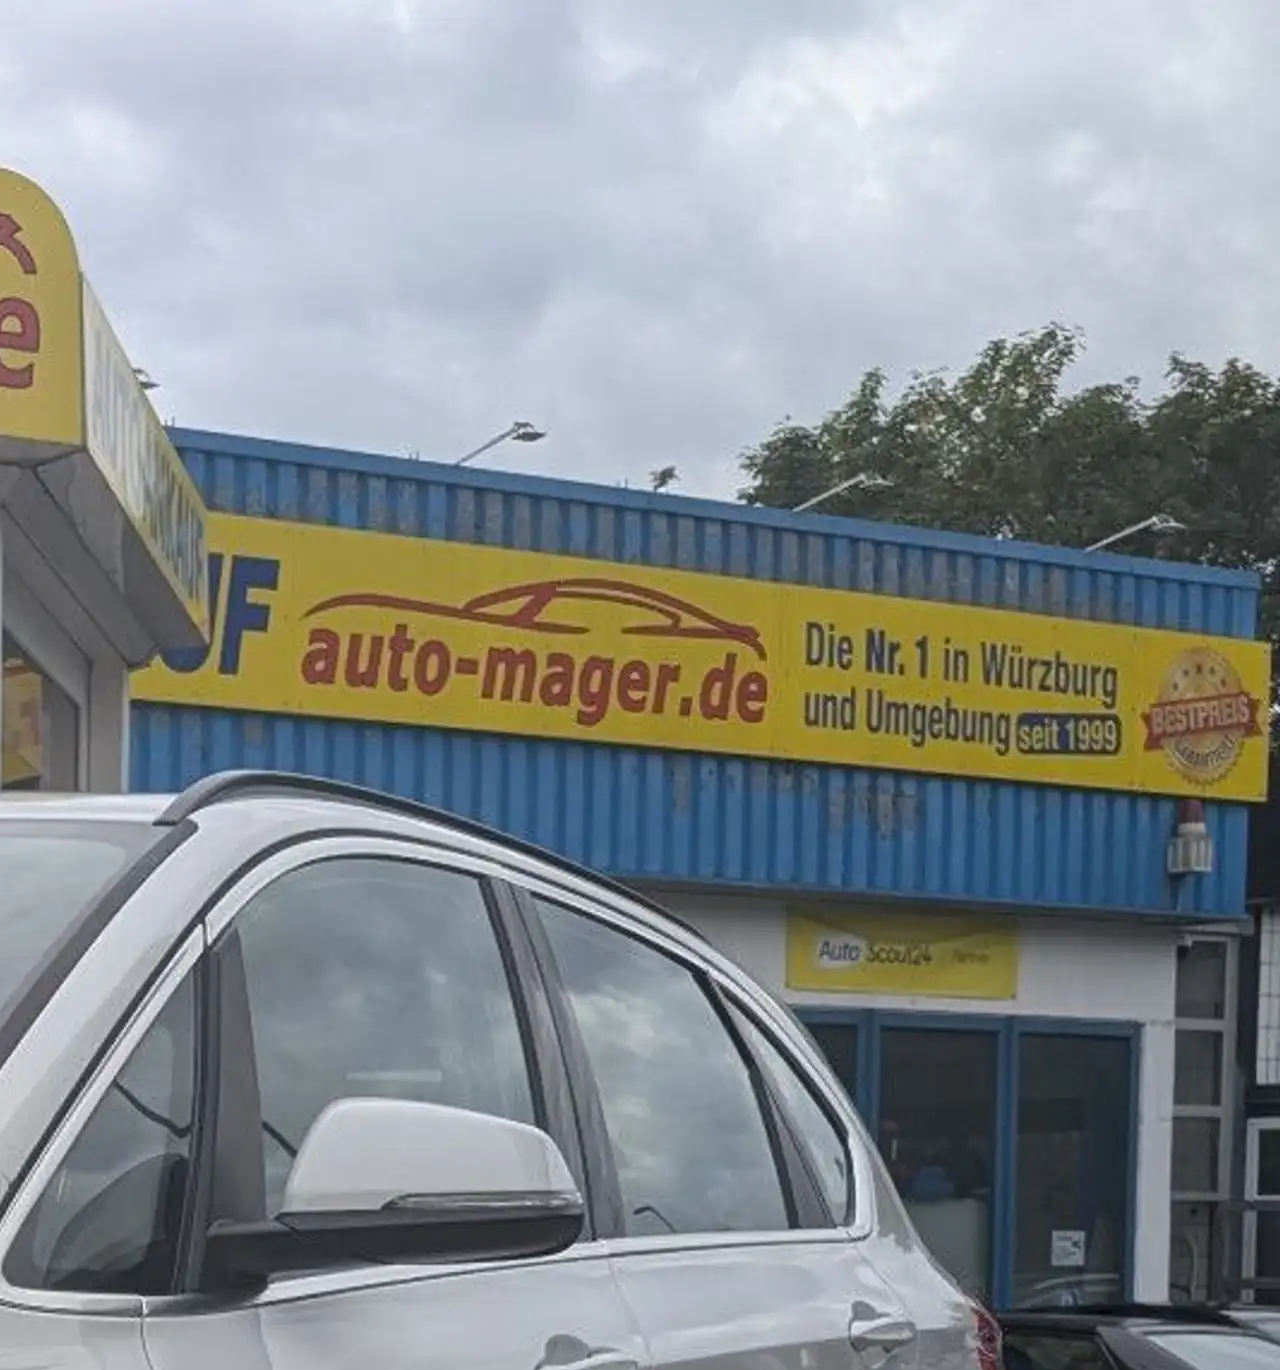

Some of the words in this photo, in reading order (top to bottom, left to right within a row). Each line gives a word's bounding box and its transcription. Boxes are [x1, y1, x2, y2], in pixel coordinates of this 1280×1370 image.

[301, 624, 768, 727] auto-mager.de
[805, 621, 854, 671] Die
[865, 628, 905, 677] Nr.
[915, 635, 929, 679] 1
[944, 637, 969, 683] in
[980, 641, 1118, 709] Würzburg
[804, 687, 857, 730] und
[865, 688, 1011, 756] Umgebung
[1017, 718, 1060, 750] seit
[1066, 719, 1118, 751] 1999
